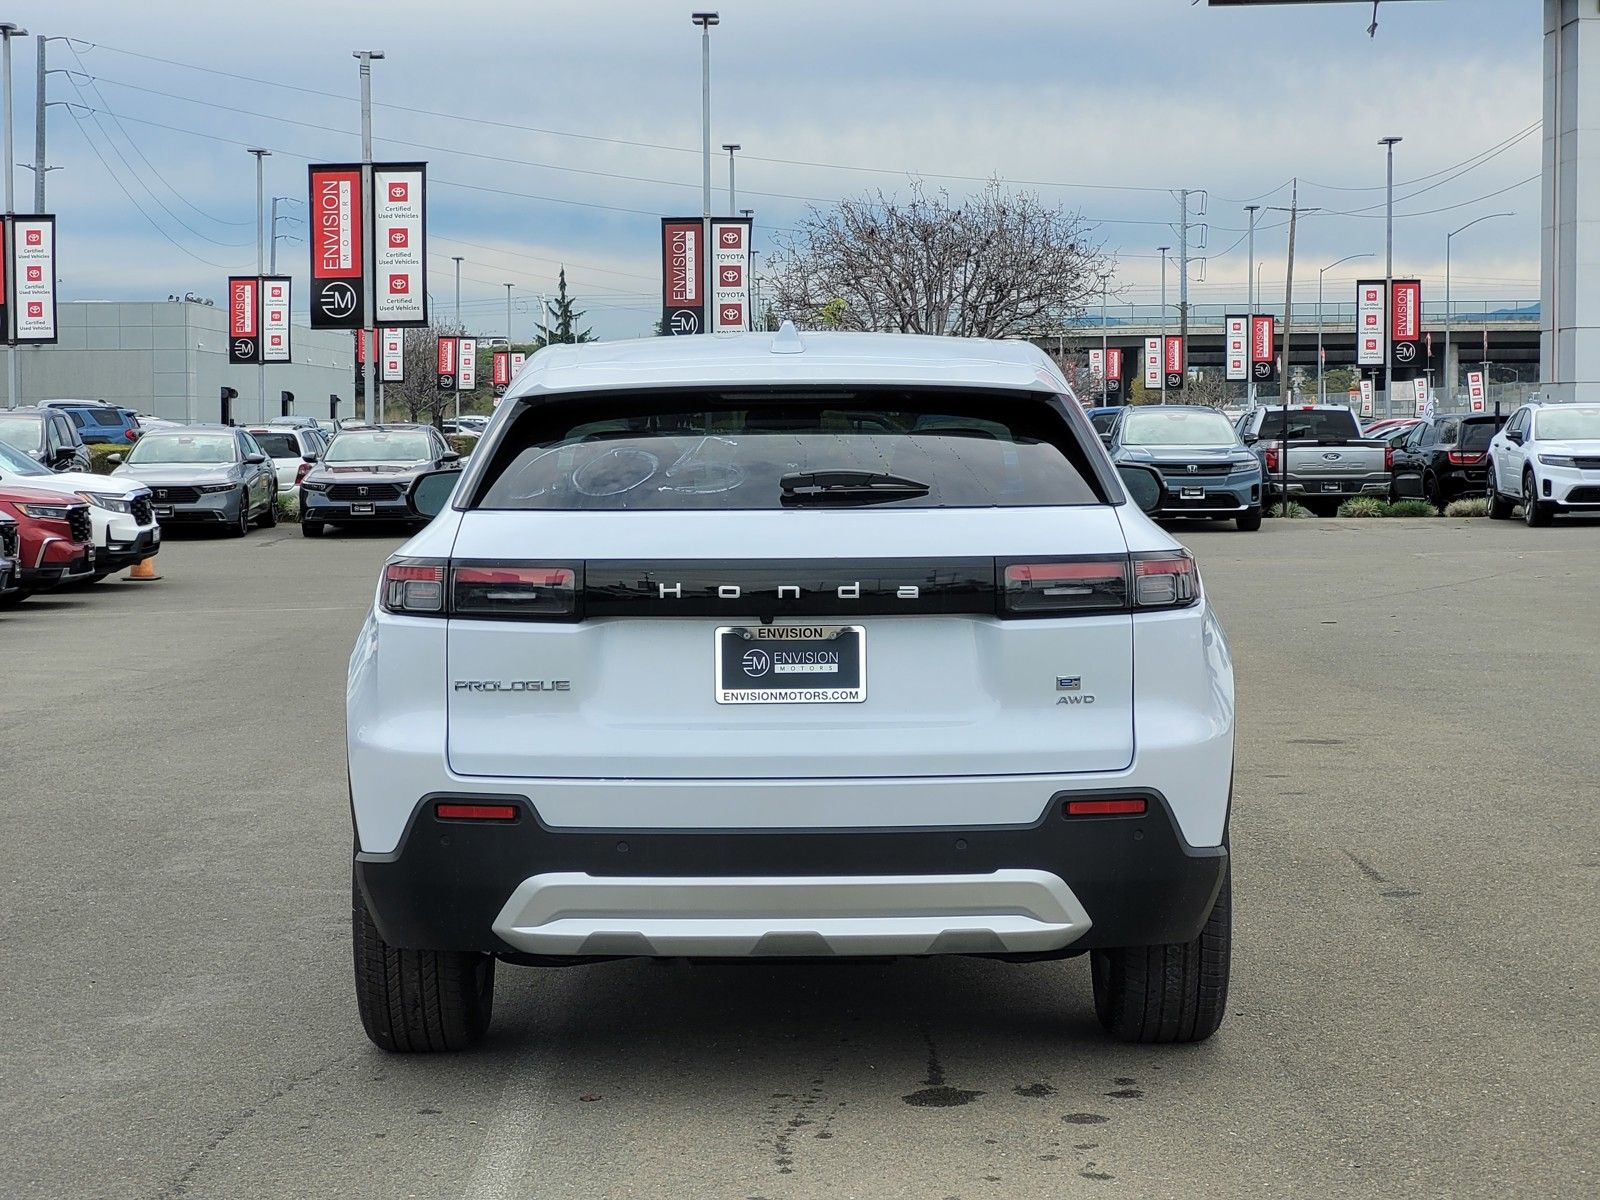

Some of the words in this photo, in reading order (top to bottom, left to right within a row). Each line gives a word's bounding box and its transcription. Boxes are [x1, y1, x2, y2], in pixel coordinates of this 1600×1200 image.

[323, 180, 339, 270] ENVISION
[342, 189, 350, 262] MOTORS
[672, 231, 686, 300] ENVISION
[236, 285, 244, 332] ENVISION
[1398, 288, 1407, 336] ENVISION
[659, 582, 920, 599] Honda
[758, 628, 823, 639] ENVISION
[774, 652, 839, 664] ENVISION
[454, 680, 571, 692] PROLOGUE
[723, 690, 859, 701] ENVISIONMOTORS.COM
[1056, 695, 1095, 705] AWD
